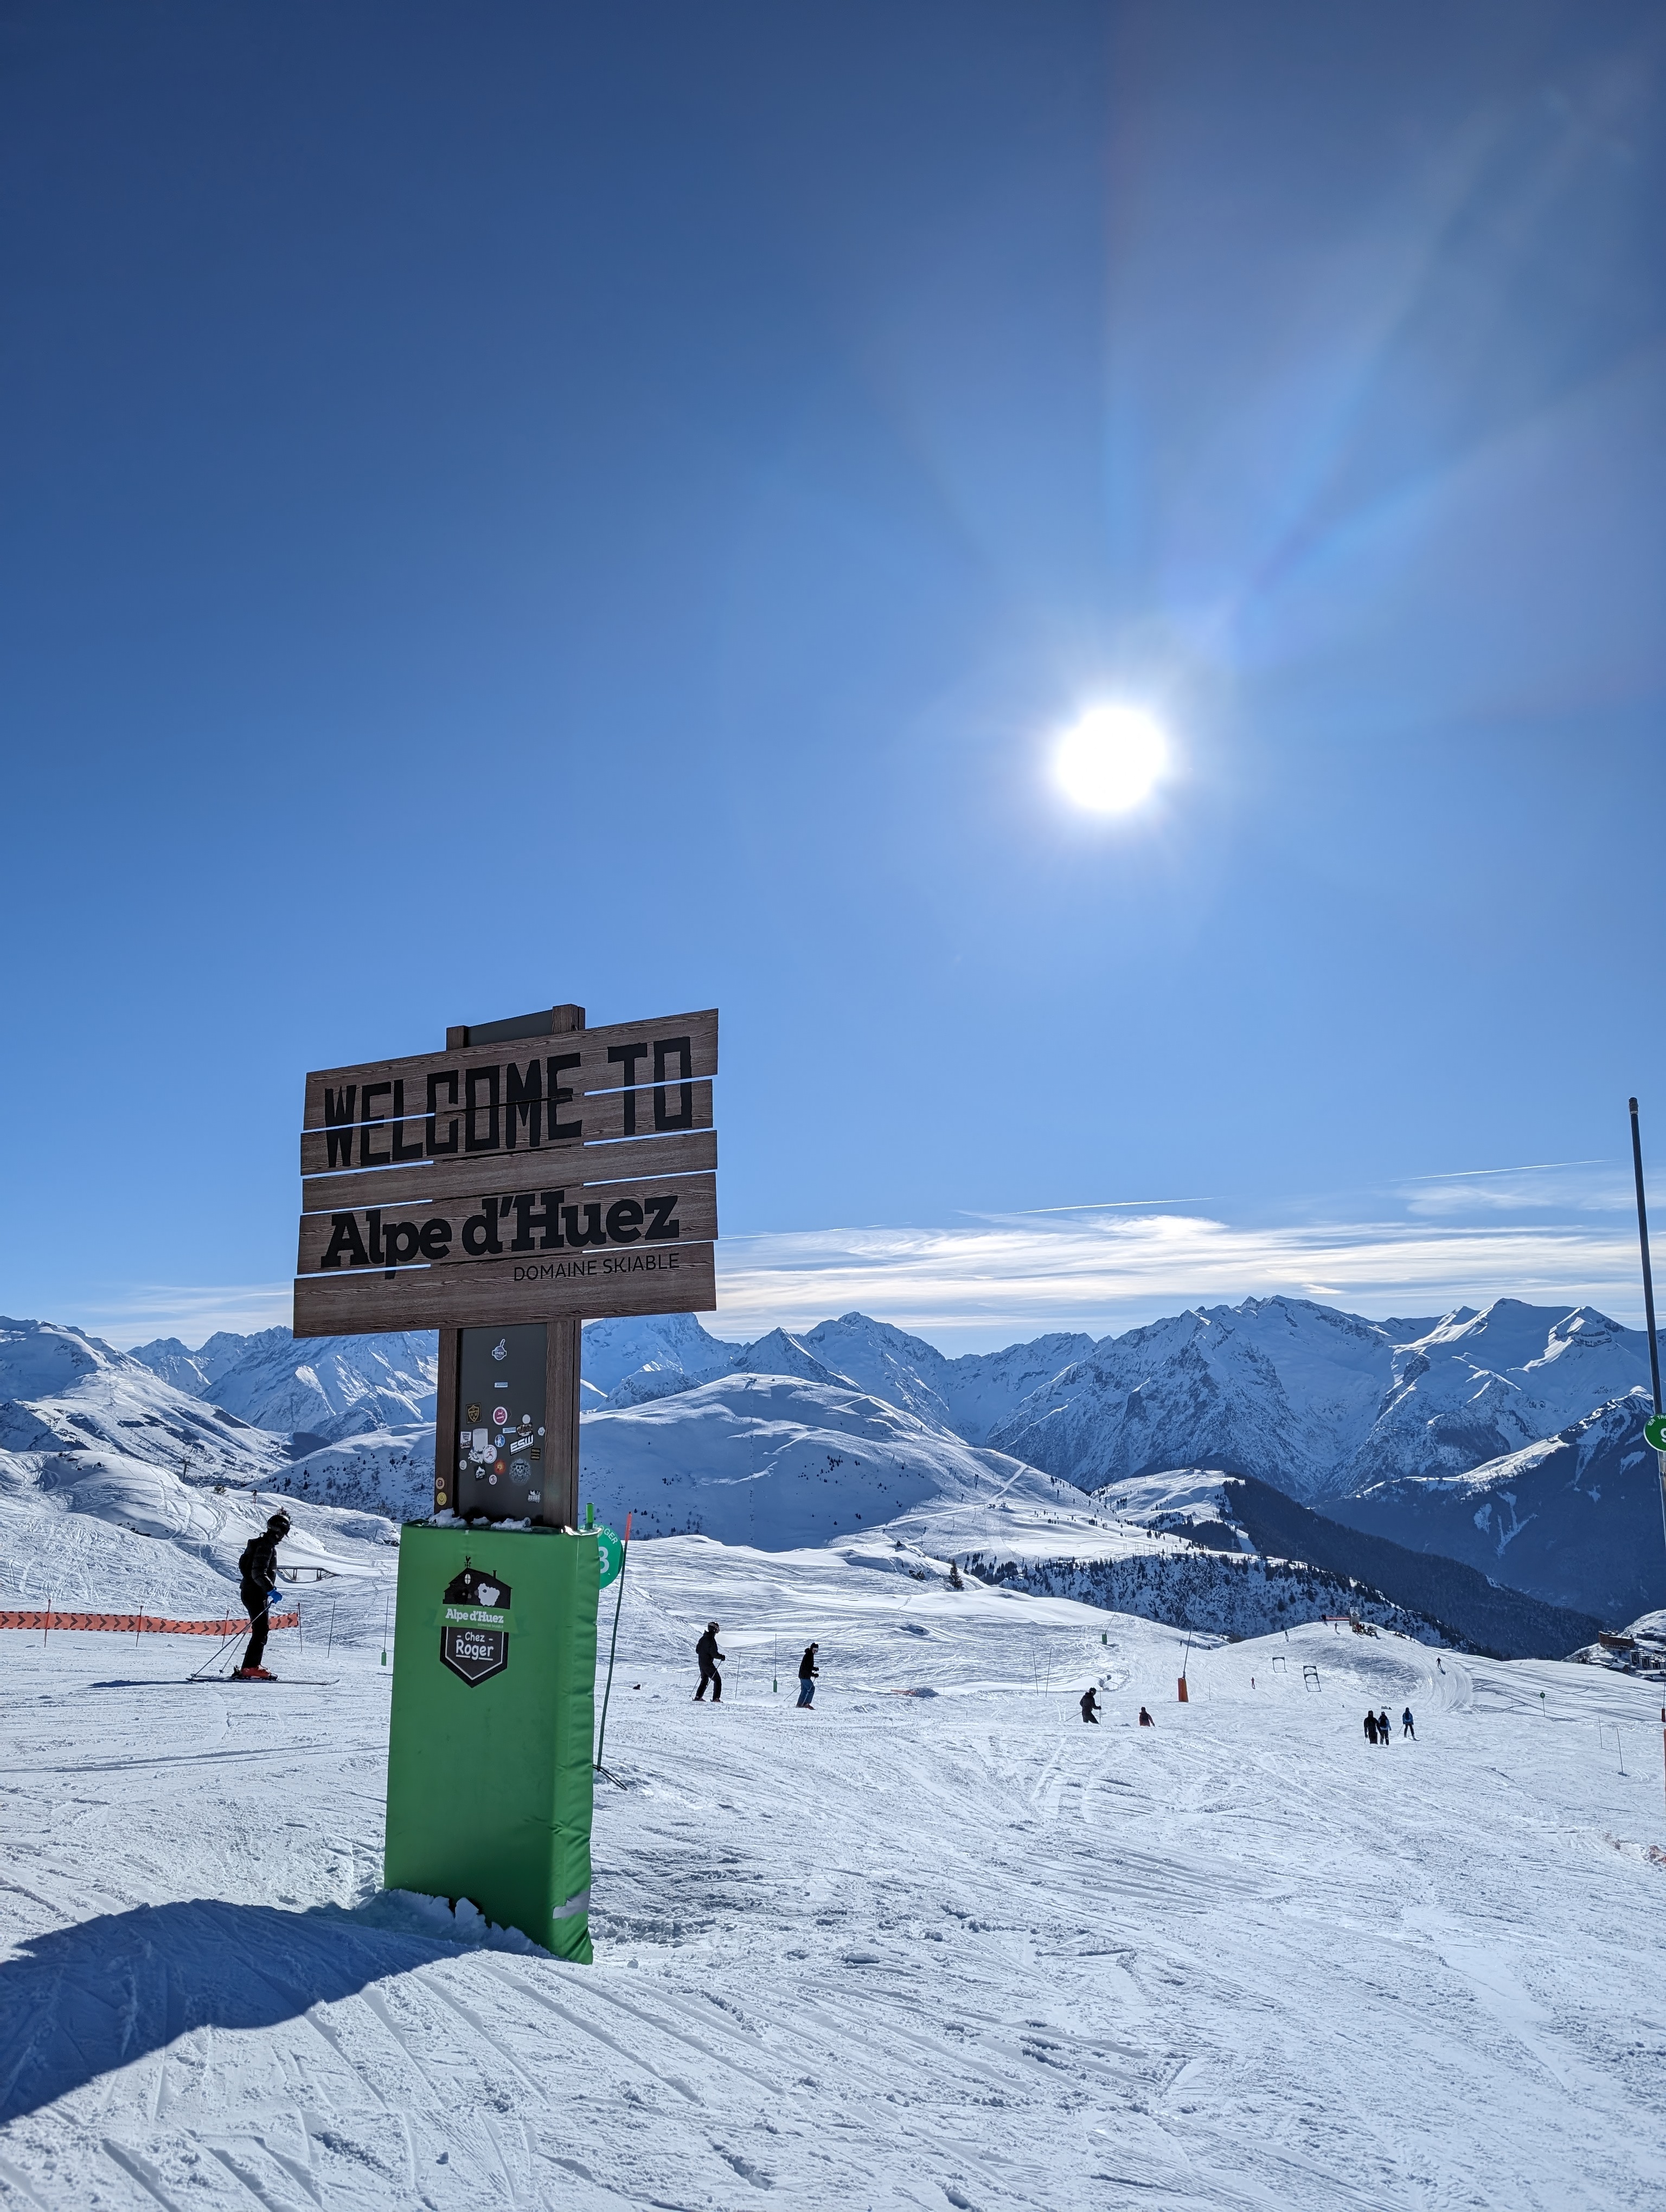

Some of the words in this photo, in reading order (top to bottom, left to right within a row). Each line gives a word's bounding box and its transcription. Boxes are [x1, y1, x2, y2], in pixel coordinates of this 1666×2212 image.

[325, 1052, 582, 1168] WELCOME
[607, 1036, 693, 1136] TO
[321, 1208, 452, 1279] Alpe
[462, 1190, 680, 1255] d'Huez
[514, 1260, 597, 1282] DOMAINE
[603, 1252, 680, 1274] SKIABLE
[445, 1608, 469, 1623] Alpe
[469, 1610, 504, 1624] d'Huez
[456, 1639, 494, 1661] Roger
[465, 1631, 485, 1643] Chez
